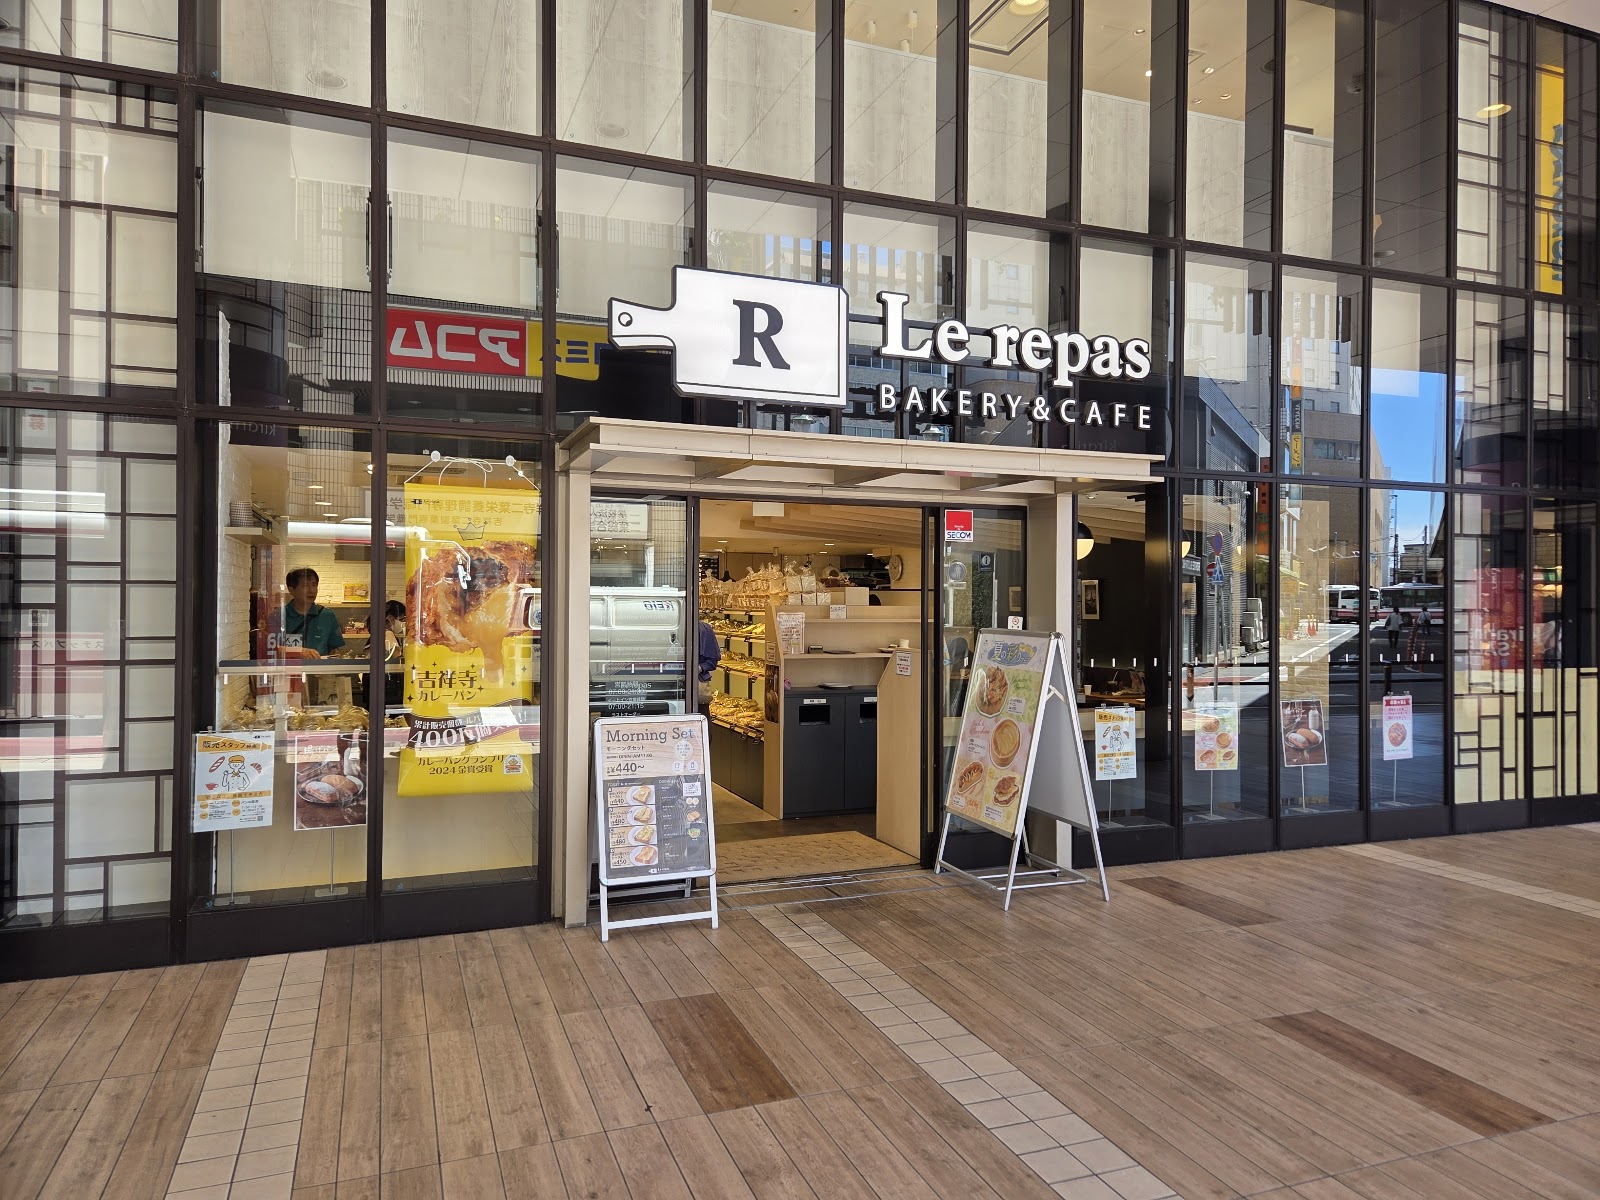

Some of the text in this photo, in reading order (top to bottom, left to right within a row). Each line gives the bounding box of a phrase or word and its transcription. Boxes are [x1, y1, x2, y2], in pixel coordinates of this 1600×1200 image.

[732, 299, 790, 369] R
[878, 292, 1151, 387] Le repas
[946, 531, 972, 540] SECOM
[417, 670, 478, 689] 吉祥寺
[417, 690, 477, 702] カレーパン
[606, 727, 695, 743] Morning Set
[429, 766, 456, 775] 2024
[457, 764, 494, 775] 金賞受賞
